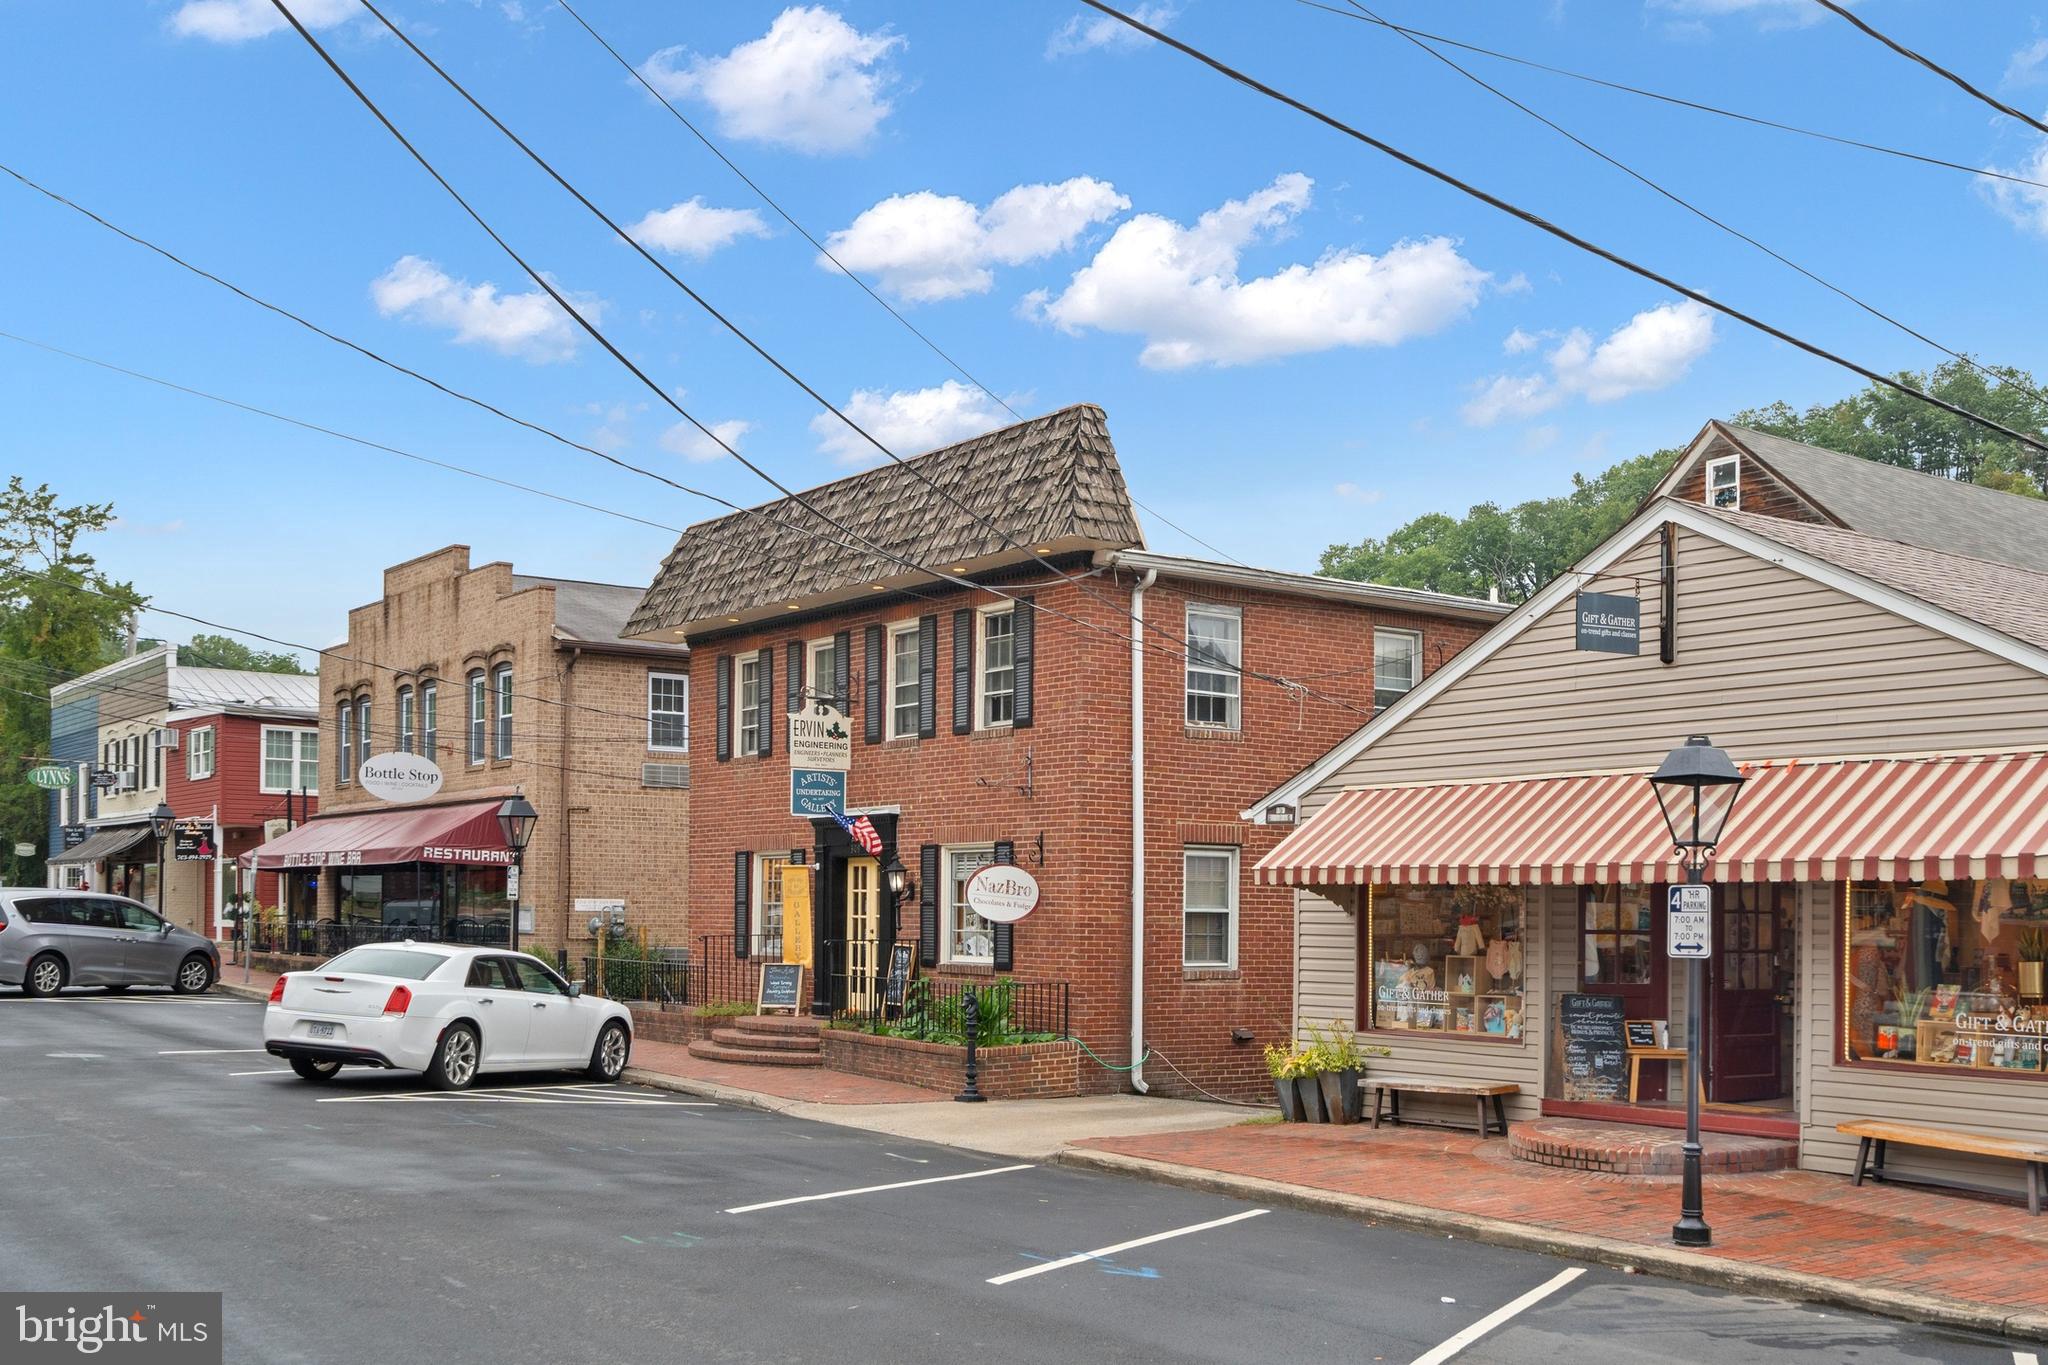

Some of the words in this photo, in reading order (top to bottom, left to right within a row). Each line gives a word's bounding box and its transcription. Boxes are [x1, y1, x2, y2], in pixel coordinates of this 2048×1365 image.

[1582, 611, 1599, 624] GIFT
[1600, 613, 1607, 625] &
[1607, 614, 1636, 627] GATHER
[793, 719, 824, 738] ERVIN
[793, 740, 848, 750] ENGINEERING
[365, 766, 405, 780] Bottle
[409, 768, 439, 784] Stop
[796, 788, 841, 797] UNDERTAKING
[284, 853, 308, 867] BOTTLE
[309, 852, 327, 866] STOP
[328, 851, 346, 865] WINE
[347, 851, 361, 864] BAR
[975, 876, 1033, 897] NazBro
[1688, 890, 1700, 899] HR
[973, 896, 1005, 907] Chocolates
[1013, 902, 1032, 910] Fudge
[1671, 891, 1681, 909] 4
[1683, 901, 1706, 910] PARKING
[1674, 916, 1691, 924] 7:00
[1379, 985, 1399, 999] GIFT
[1402, 985, 1411, 1000] &
[1412, 987, 1449, 1001] GATHER
[1955, 1012, 1991, 1030] GIFT
[1995, 1014, 2009, 1031] &
[1952, 1037, 1995, 1048] on-trend
[2021, 1041, 2042, 1050] and
